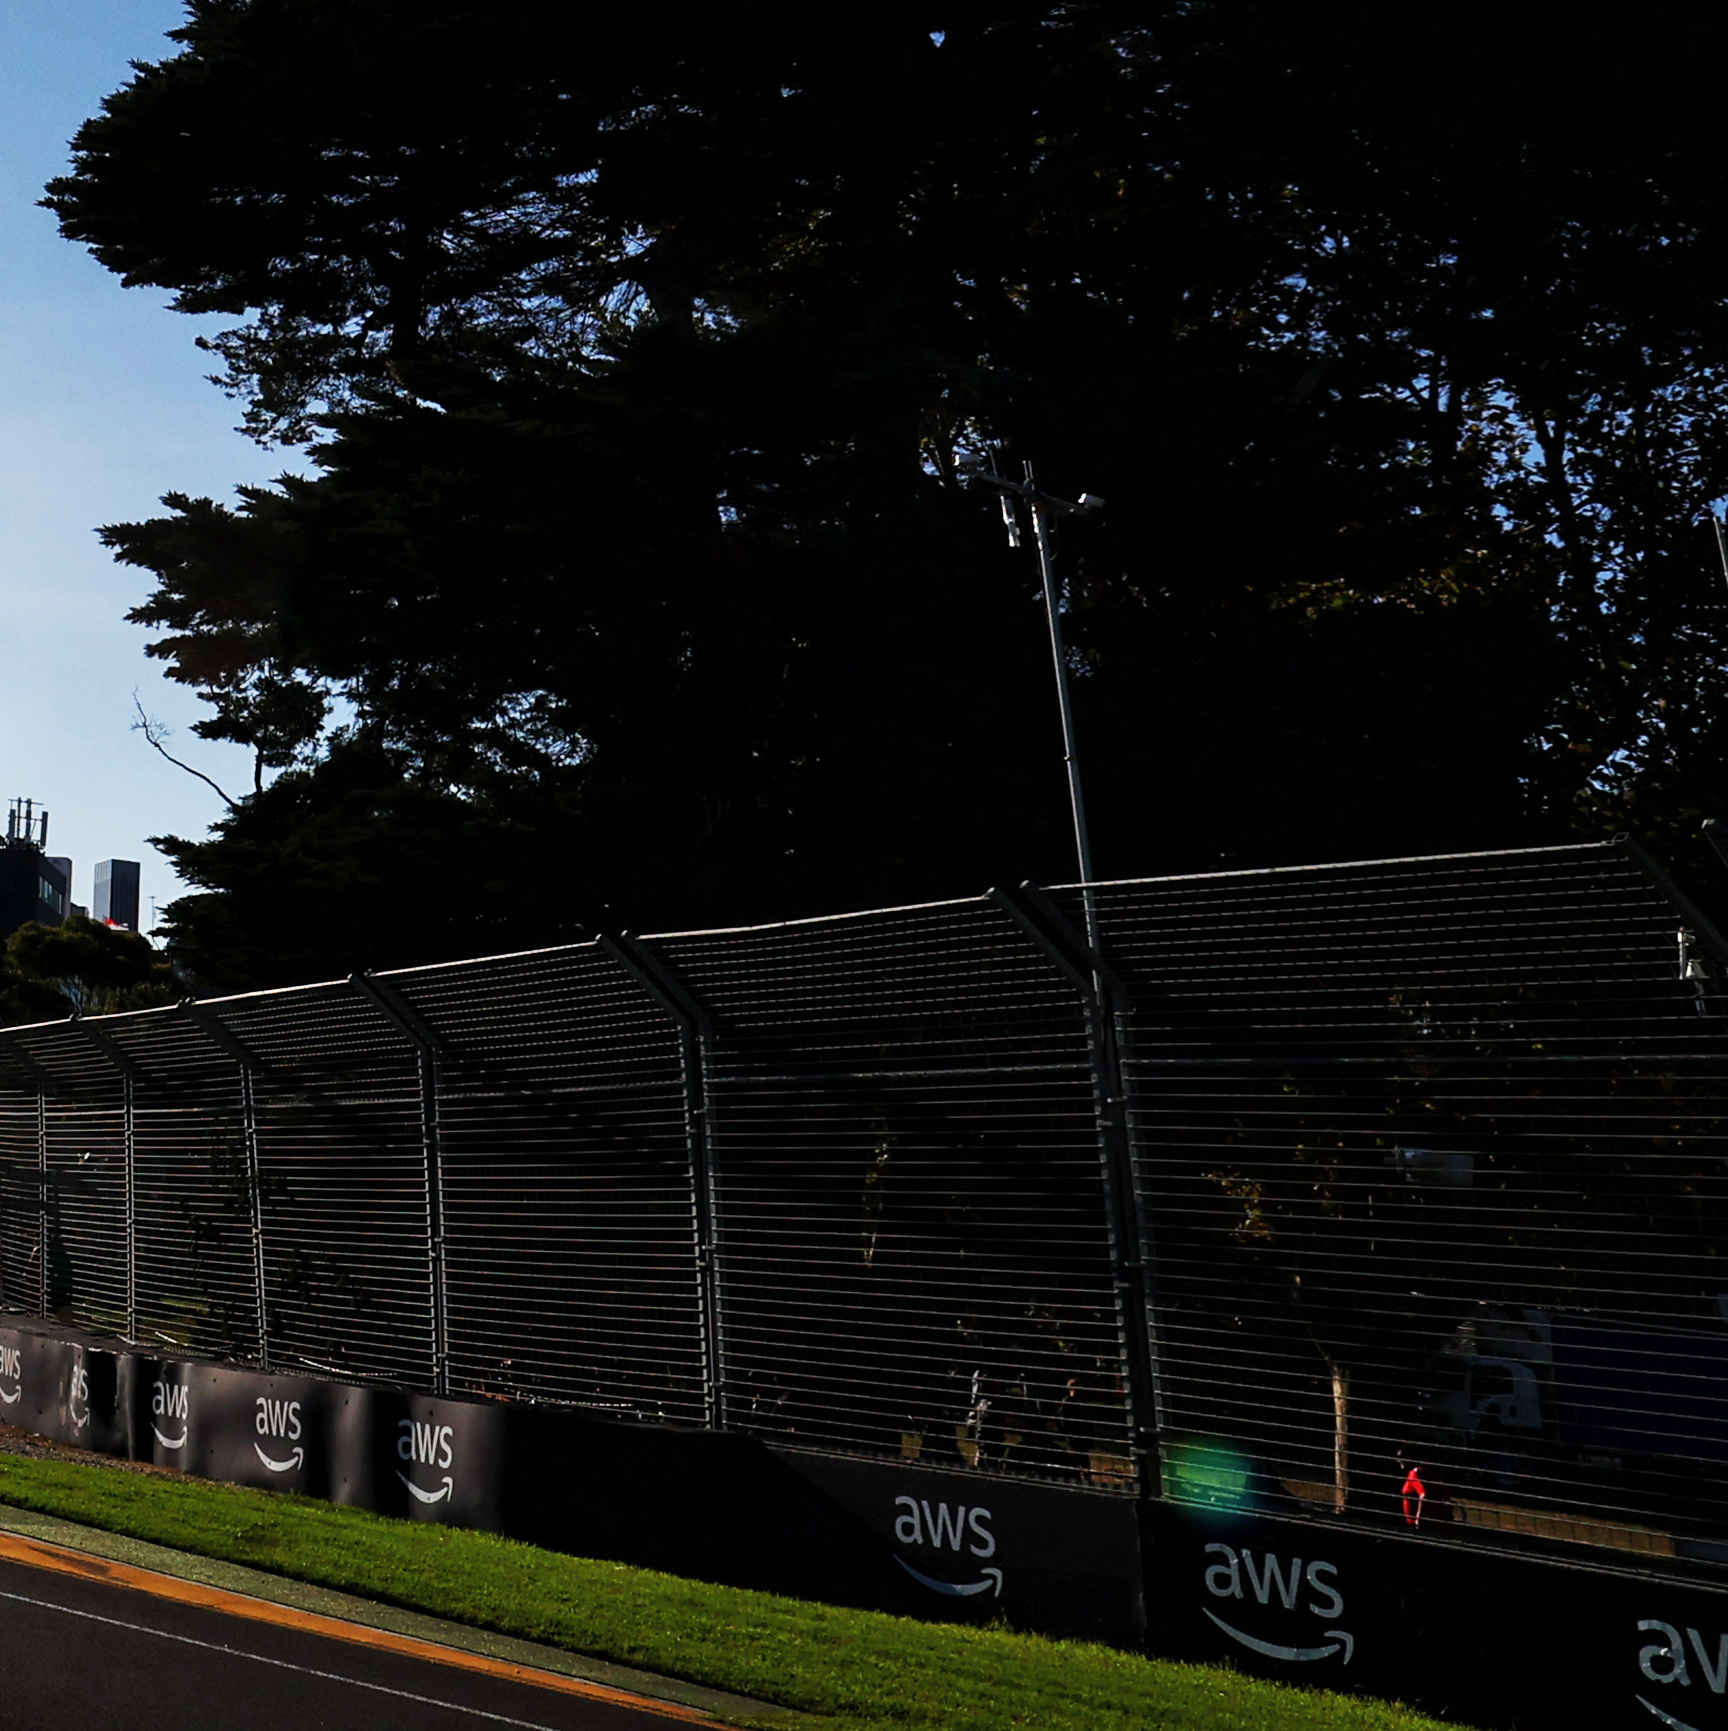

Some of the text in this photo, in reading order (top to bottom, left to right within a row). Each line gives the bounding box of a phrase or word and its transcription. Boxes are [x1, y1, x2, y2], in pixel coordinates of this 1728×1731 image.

[152, 1380, 189, 1421] aws
[255, 1396, 302, 1441] aws
[397, 1419, 454, 1469] aws
[894, 1495, 997, 1559] aws
[1204, 1542, 1344, 1619] aws
[1636, 1619, 1728, 1694] aw
